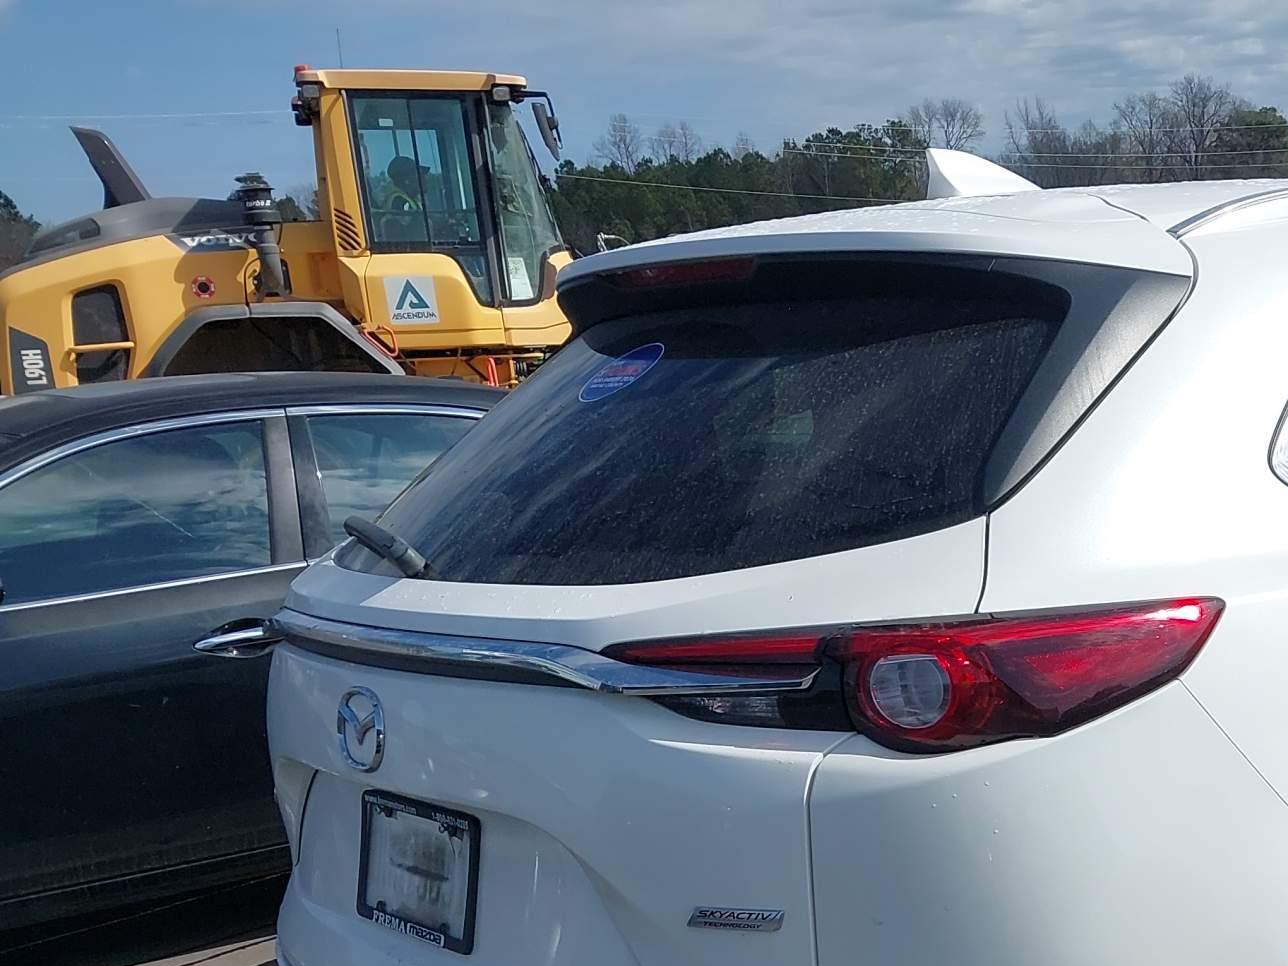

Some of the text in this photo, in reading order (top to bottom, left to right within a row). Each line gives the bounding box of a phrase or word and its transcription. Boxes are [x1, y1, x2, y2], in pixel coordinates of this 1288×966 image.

[392, 311, 437, 321] ASCENDUM
[20, 349, 48, 385] L90H
[696, 909, 775, 921] SKYACTIV
[372, 910, 441, 945] FREMA mazda
[702, 920, 763, 930] TECHNOLOGY
